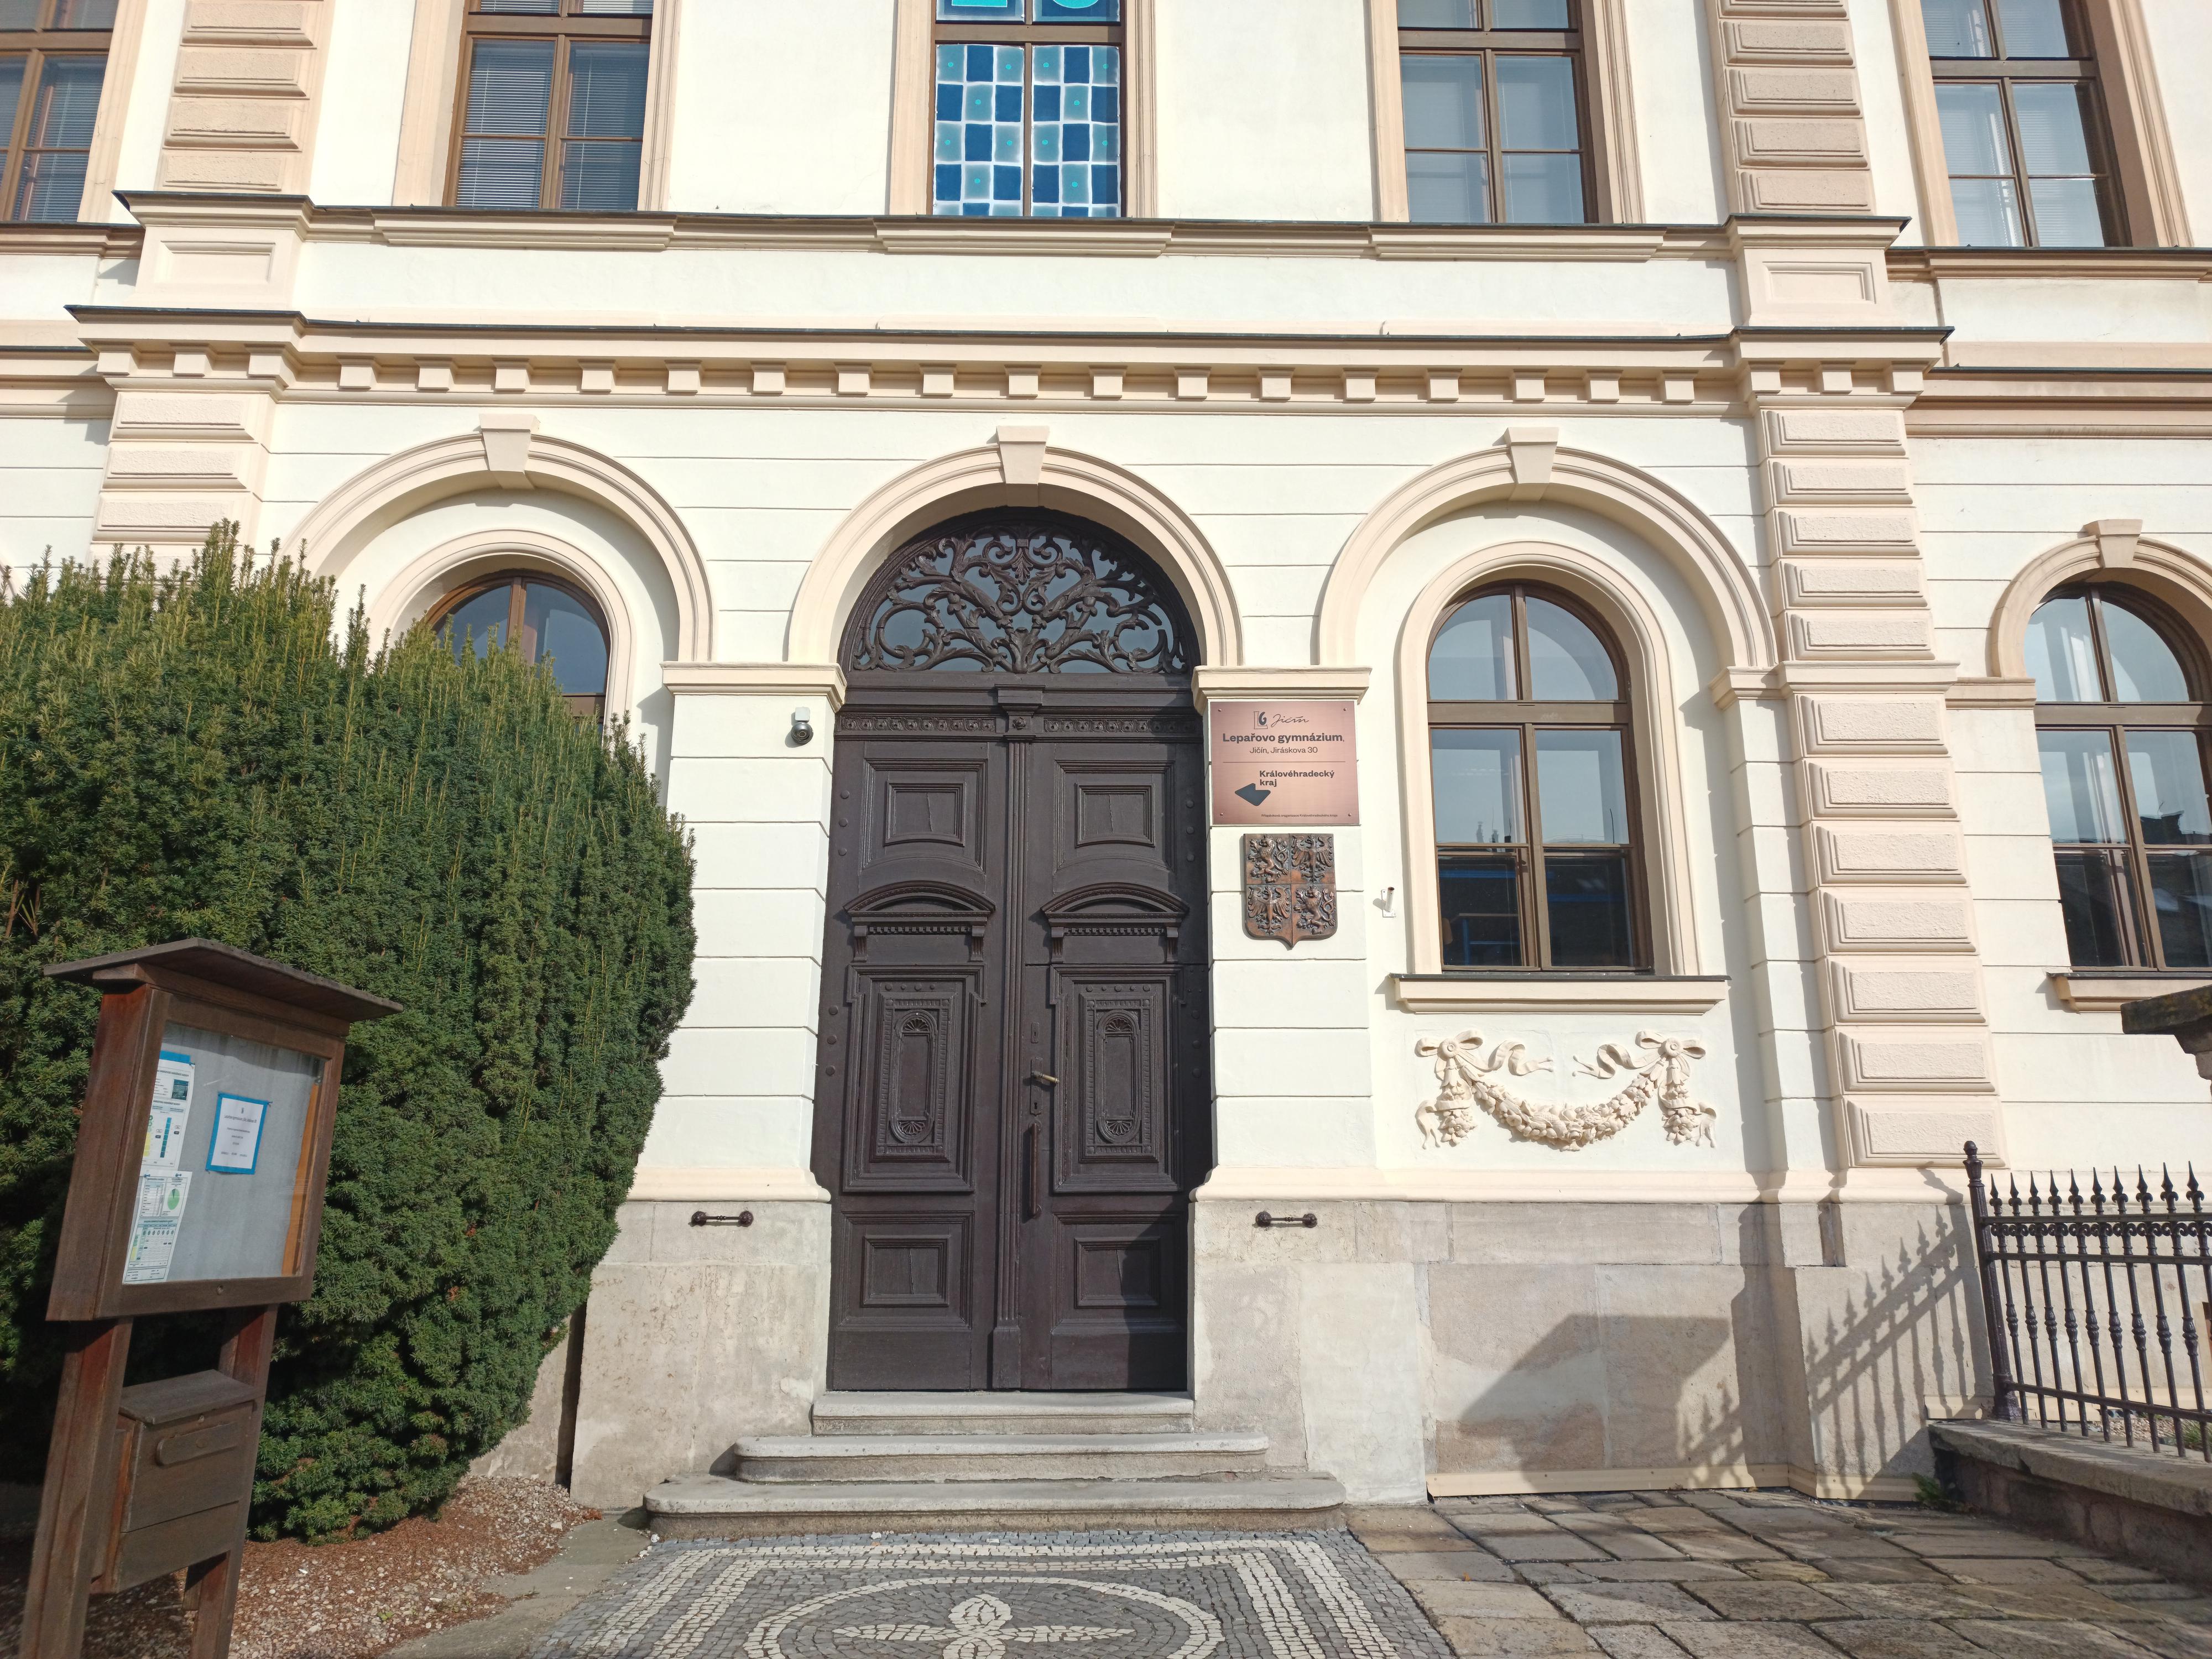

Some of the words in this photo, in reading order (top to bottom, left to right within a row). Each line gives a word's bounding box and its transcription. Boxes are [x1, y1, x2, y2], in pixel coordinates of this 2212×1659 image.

[1223, 733, 1275, 743] Lepařovo
[1278, 733, 1344, 743] gymnázium,
[1259, 770, 1335, 778] Královéhradecký
[1260, 779, 1277, 787] kraj
